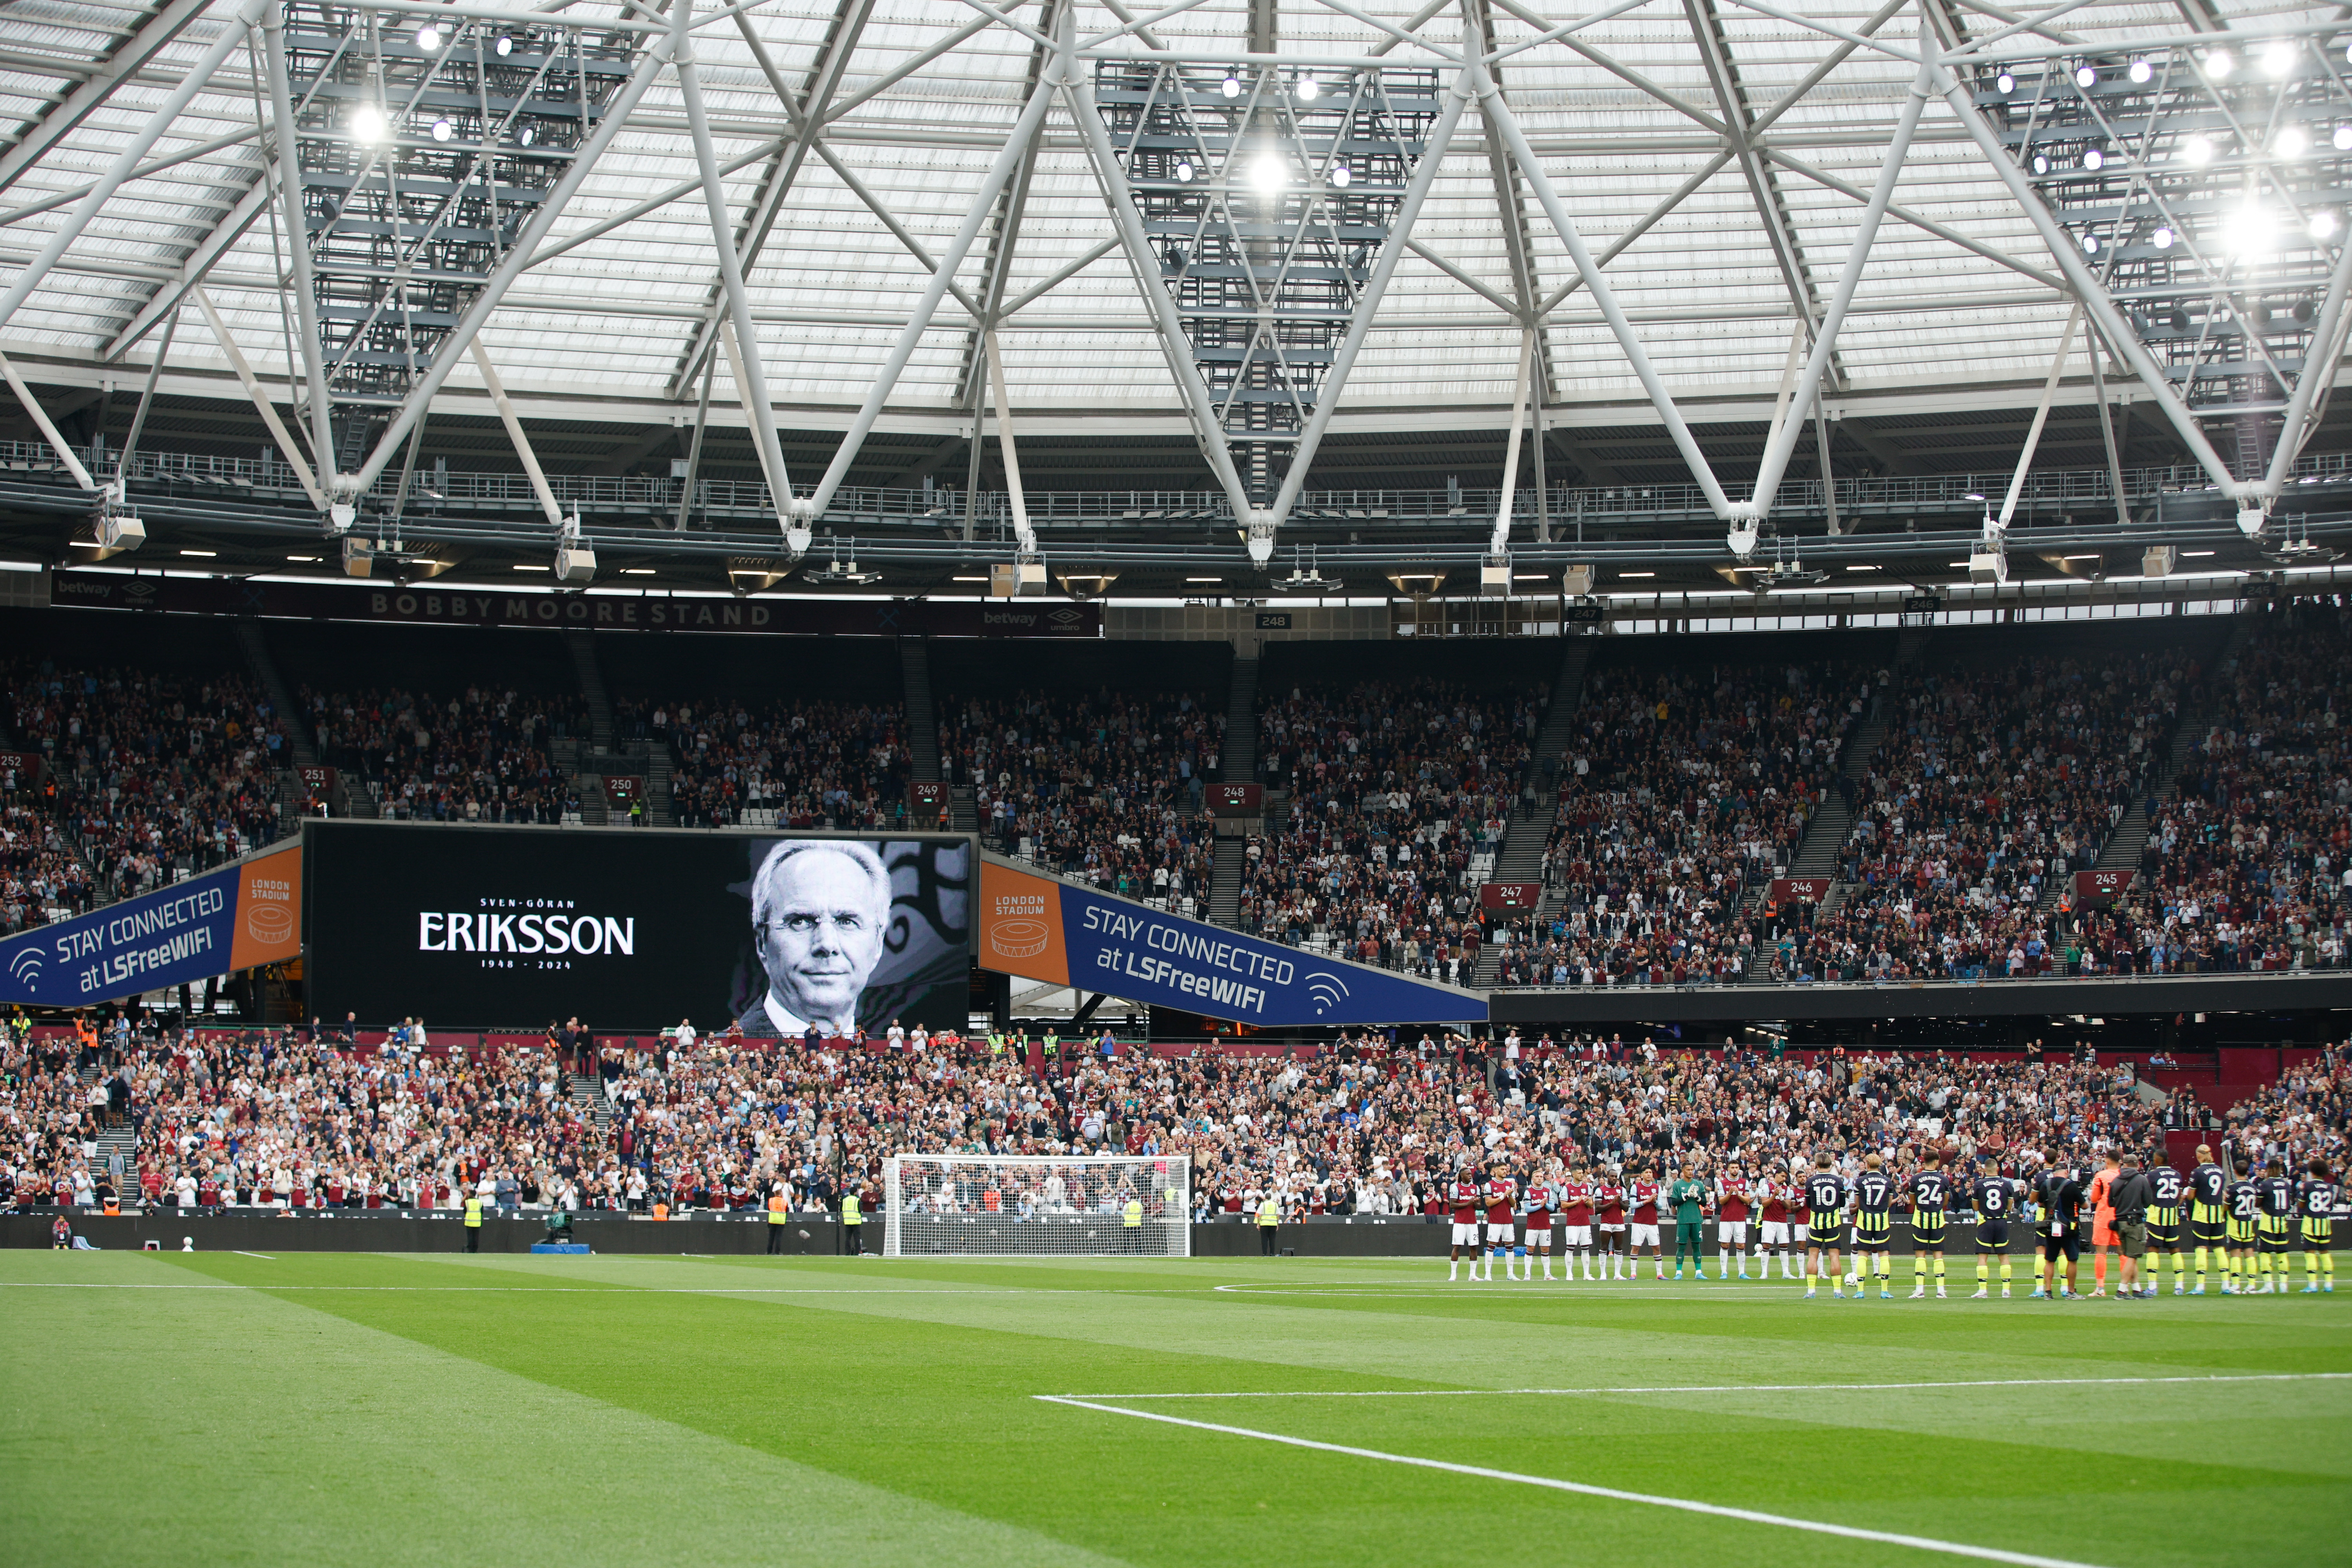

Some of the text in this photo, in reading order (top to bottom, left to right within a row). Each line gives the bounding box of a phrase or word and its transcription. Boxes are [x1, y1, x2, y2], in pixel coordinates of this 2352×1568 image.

[58, 580, 112, 598] betway
[2247, 586, 2270, 595] 245
[125, 596, 154, 604] umbro
[1911, 600, 1934, 610] 246
[371, 593, 769, 625] BOBBY MOORE STAND
[1574, 609, 1597, 619] 247
[984, 612, 1038, 627] betway
[1262, 617, 1285, 626] 248
[1, 755, 21, 766] 252
[305, 769, 325, 780] 251
[611, 779, 632, 789] 250
[918, 785, 938, 795] 249
[1224, 787, 1244, 797] 248
[252, 879, 289, 891] LONDON
[2096, 874, 2117, 885] 245
[1501, 887, 1522, 897] 247
[1791, 882, 1812, 893] 246
[252, 889, 289, 900] STADIUM
[480, 897, 574, 908] SVEN-GÖRAN
[996, 896, 1044, 905] LONDON
[996, 906, 1044, 915] STADIUM
[56, 887, 223, 964] STAY CONNECTED
[419, 912, 634, 955] ERIKSSON
[1083, 905, 1294, 985] STAY CONNECTED
[80, 926, 212, 993] at LSFreeWIFI
[482, 960, 514, 968] 1948
[538, 960, 571, 969] 2024
[1097, 947, 1266, 1013] at LSFreeWIFI
[2156, 1178, 2181, 1199] 25
[2209, 1174, 2222, 1196] 9
[1813, 1185, 1837, 1206] 10
[1864, 1185, 1886, 1205] 17
[1917, 1184, 1943, 1205] 24
[1986, 1189, 2002, 1210] 8
[2273, 1189, 2287, 1210] 11
[2234, 1194, 2256, 1215] 20
[2308, 1191, 2332, 1212] 82
